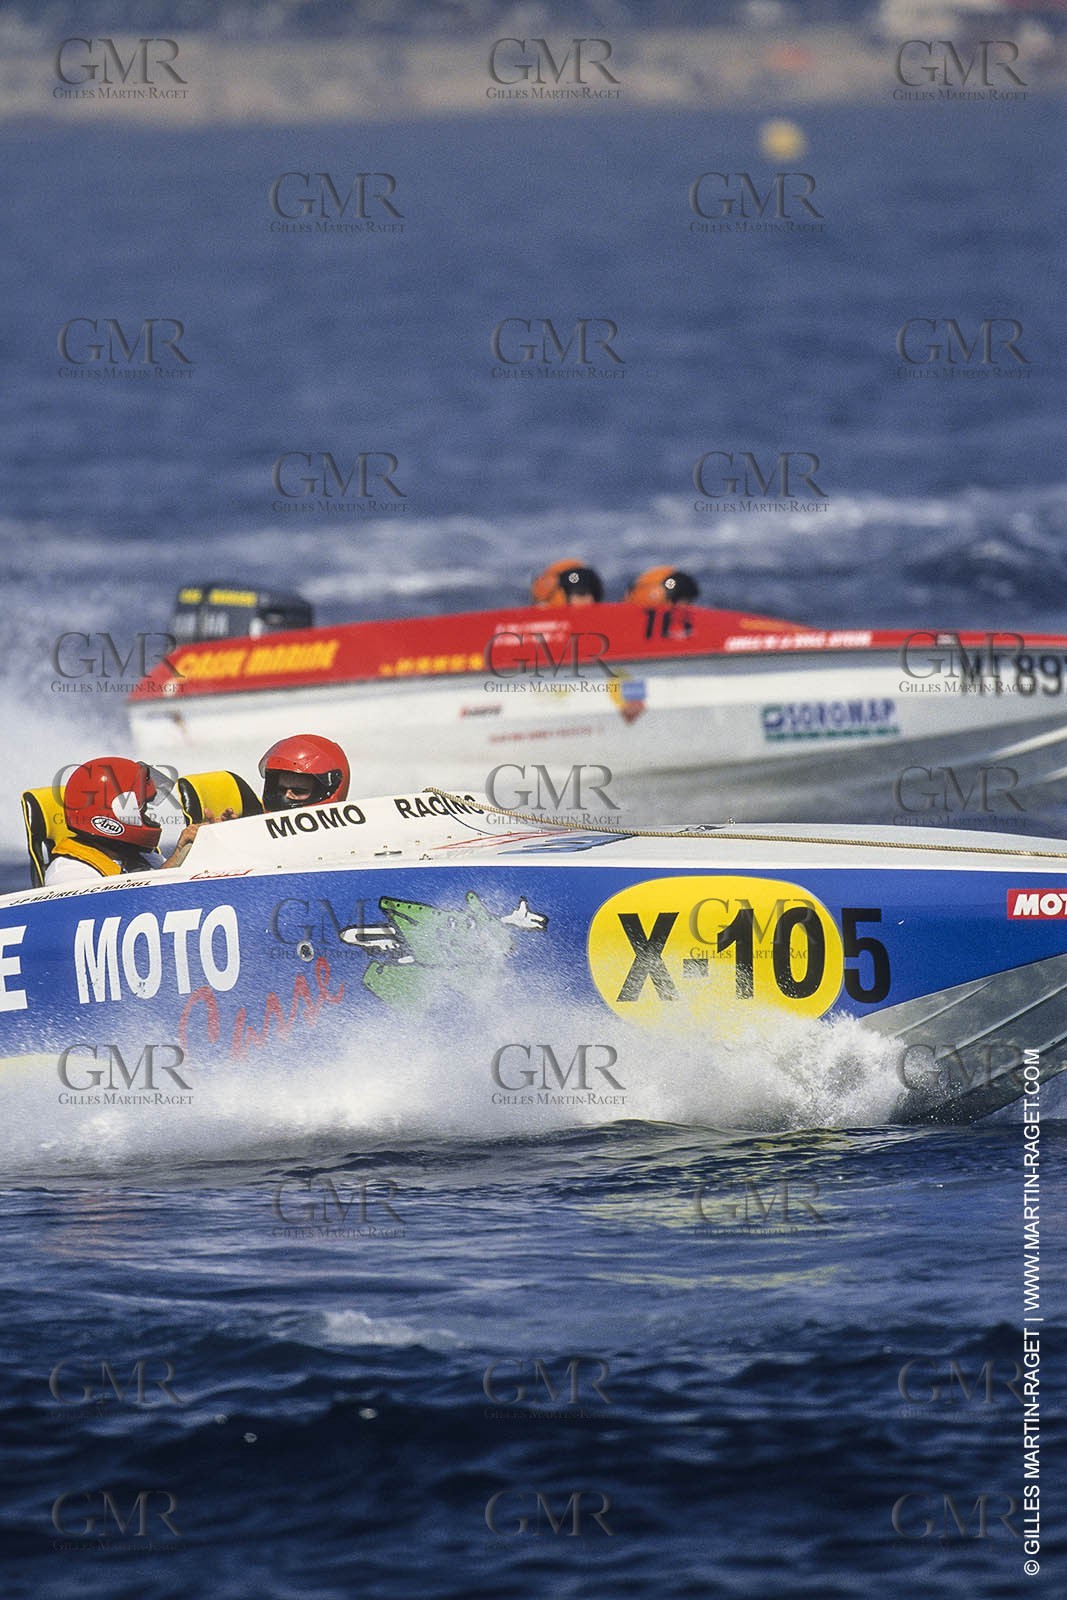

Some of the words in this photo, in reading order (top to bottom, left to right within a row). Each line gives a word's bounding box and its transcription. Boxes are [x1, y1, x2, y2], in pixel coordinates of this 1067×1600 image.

[265, 803, 366, 839] MOMO
[74, 904, 240, 1004] MOTO
[615, 905, 892, 1004] X-105
